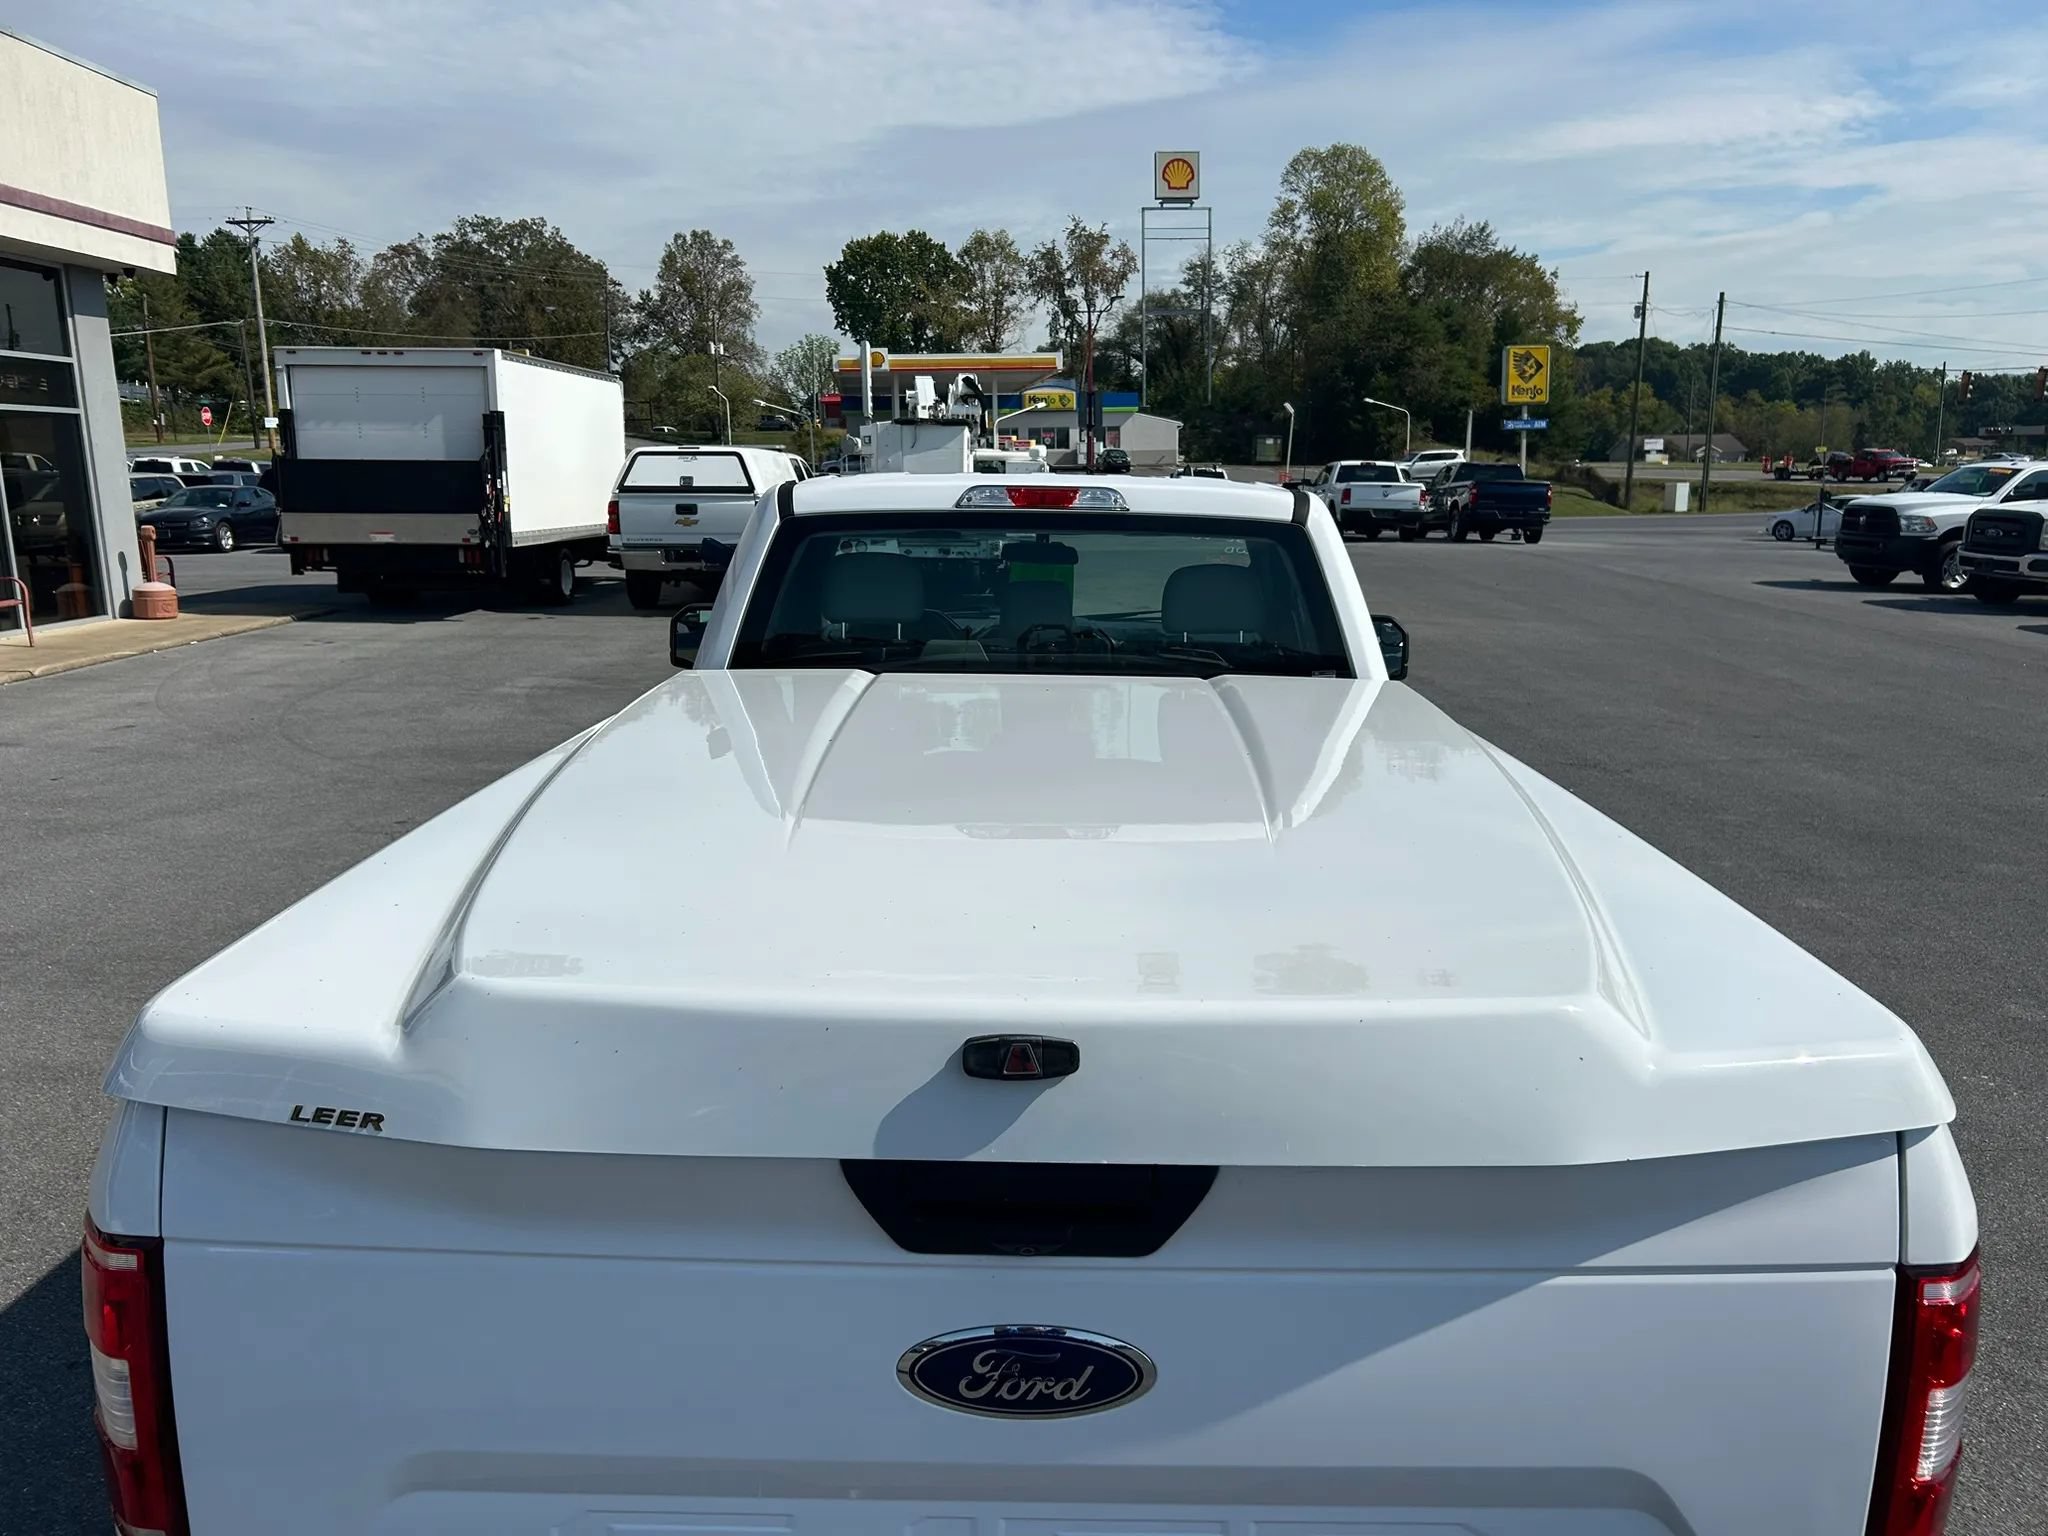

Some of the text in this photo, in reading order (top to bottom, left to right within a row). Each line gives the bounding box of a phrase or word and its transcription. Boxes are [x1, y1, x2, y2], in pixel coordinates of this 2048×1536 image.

[1533, 420, 1547, 428] ATM
[290, 1104, 385, 1132] LEER
[958, 1348, 1095, 1401] Ford
